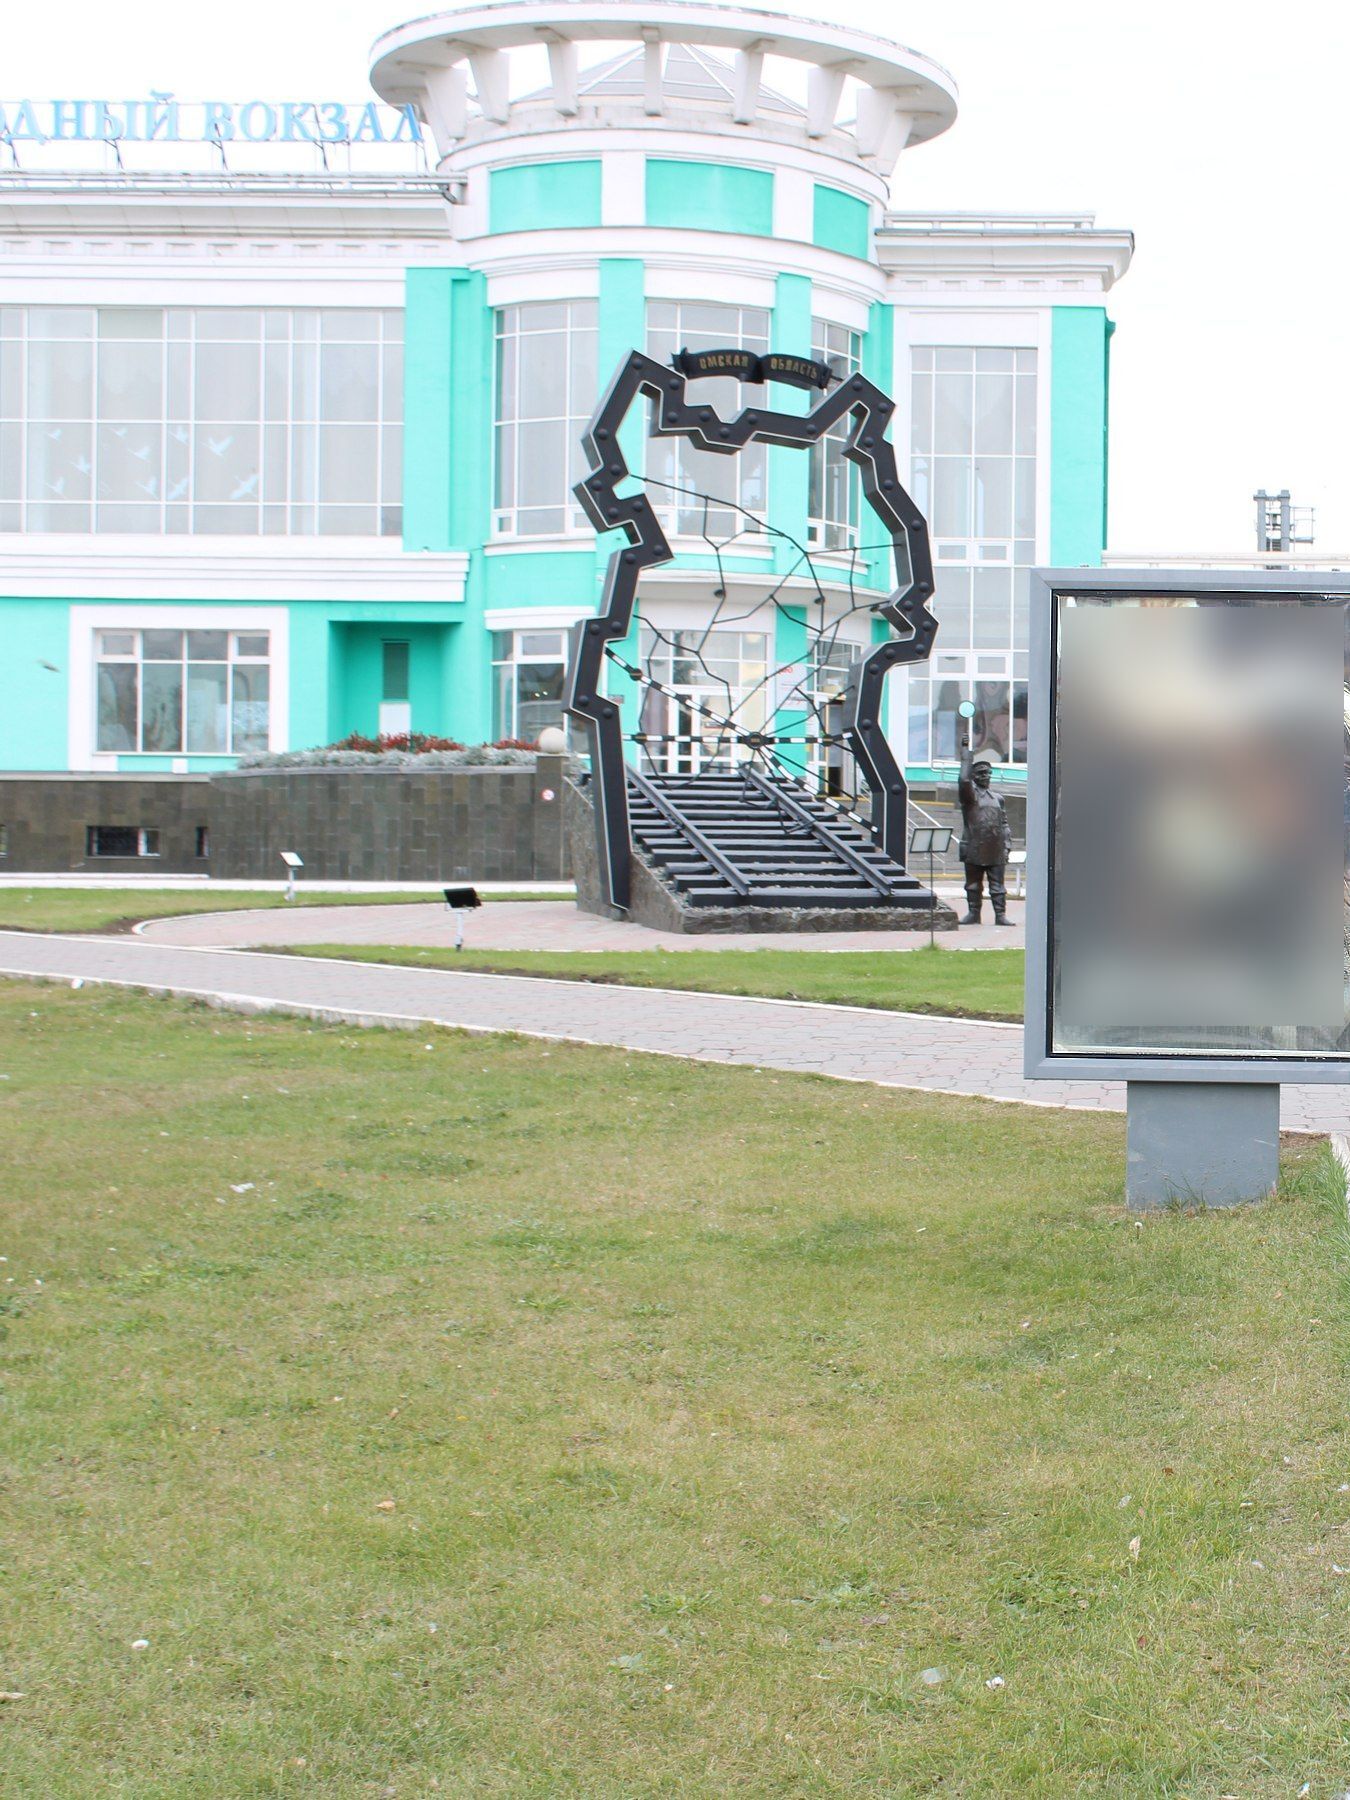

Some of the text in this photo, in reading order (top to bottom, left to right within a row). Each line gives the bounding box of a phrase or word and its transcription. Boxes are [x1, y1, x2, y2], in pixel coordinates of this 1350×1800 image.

[0, 89, 425, 145] ДНЫЙ ВОКЗАЛ
[699, 354, 818, 379] ОМСКАЯ ОБЛАСТЬ
